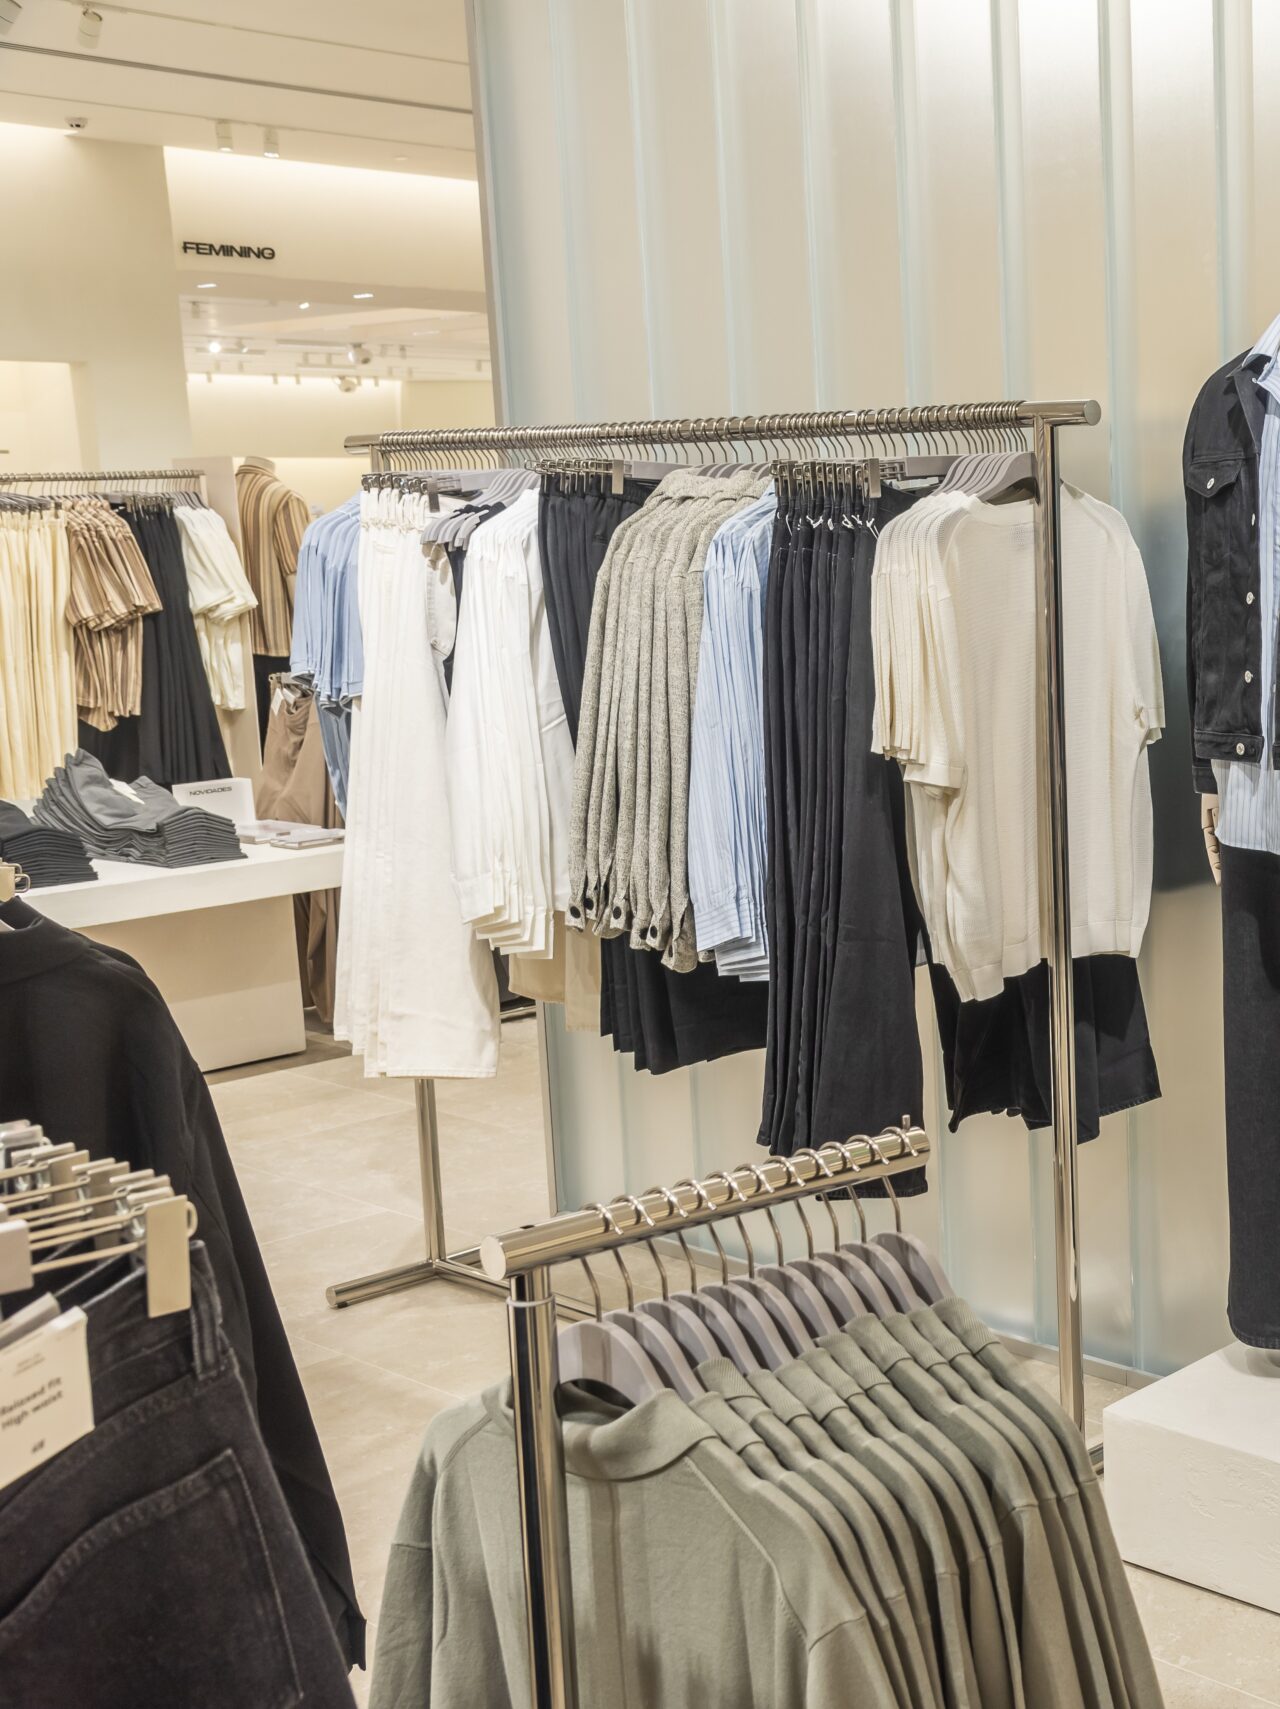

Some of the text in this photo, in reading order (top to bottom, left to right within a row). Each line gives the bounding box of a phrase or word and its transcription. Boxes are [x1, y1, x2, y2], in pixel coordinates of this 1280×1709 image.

[182, 241, 275, 260] FEMININO
[189, 786, 232, 796] NOVIDADES
[31, 1390, 63, 1413] waist
